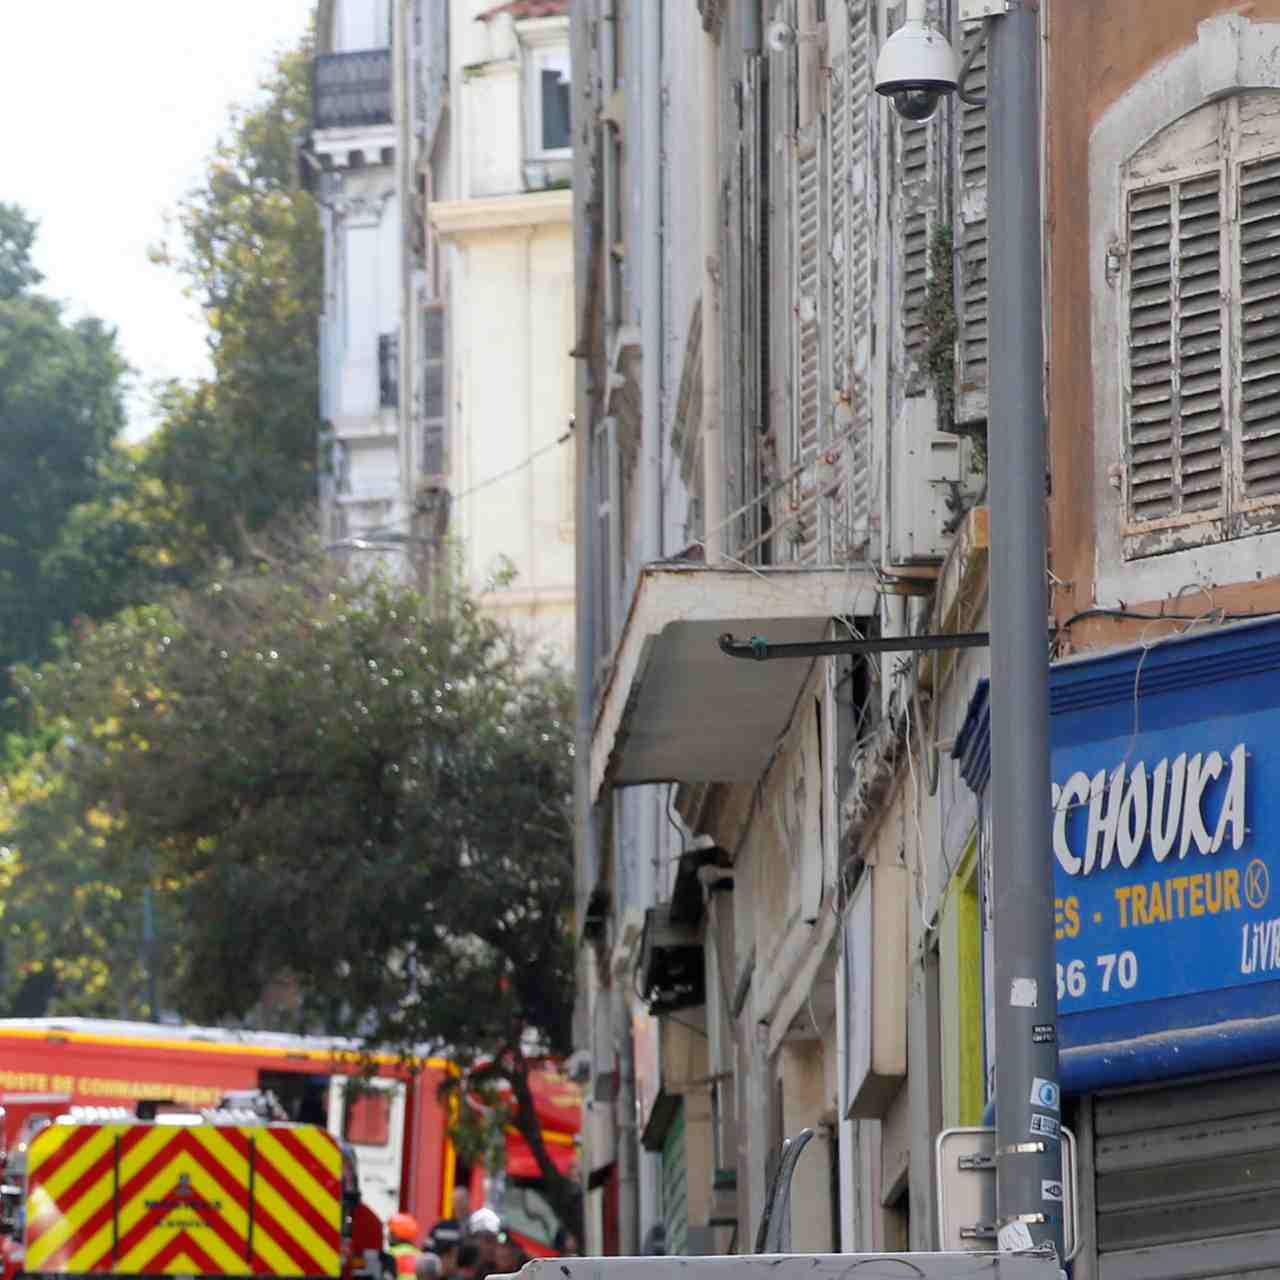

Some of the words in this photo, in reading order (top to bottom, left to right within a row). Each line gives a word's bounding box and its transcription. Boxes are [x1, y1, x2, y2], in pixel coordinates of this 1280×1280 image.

[1052, 743, 1246, 876] CHOUKA
[1115, 868, 1241, 929] TRAITEUR
[1097, 951, 1138, 993] 70
